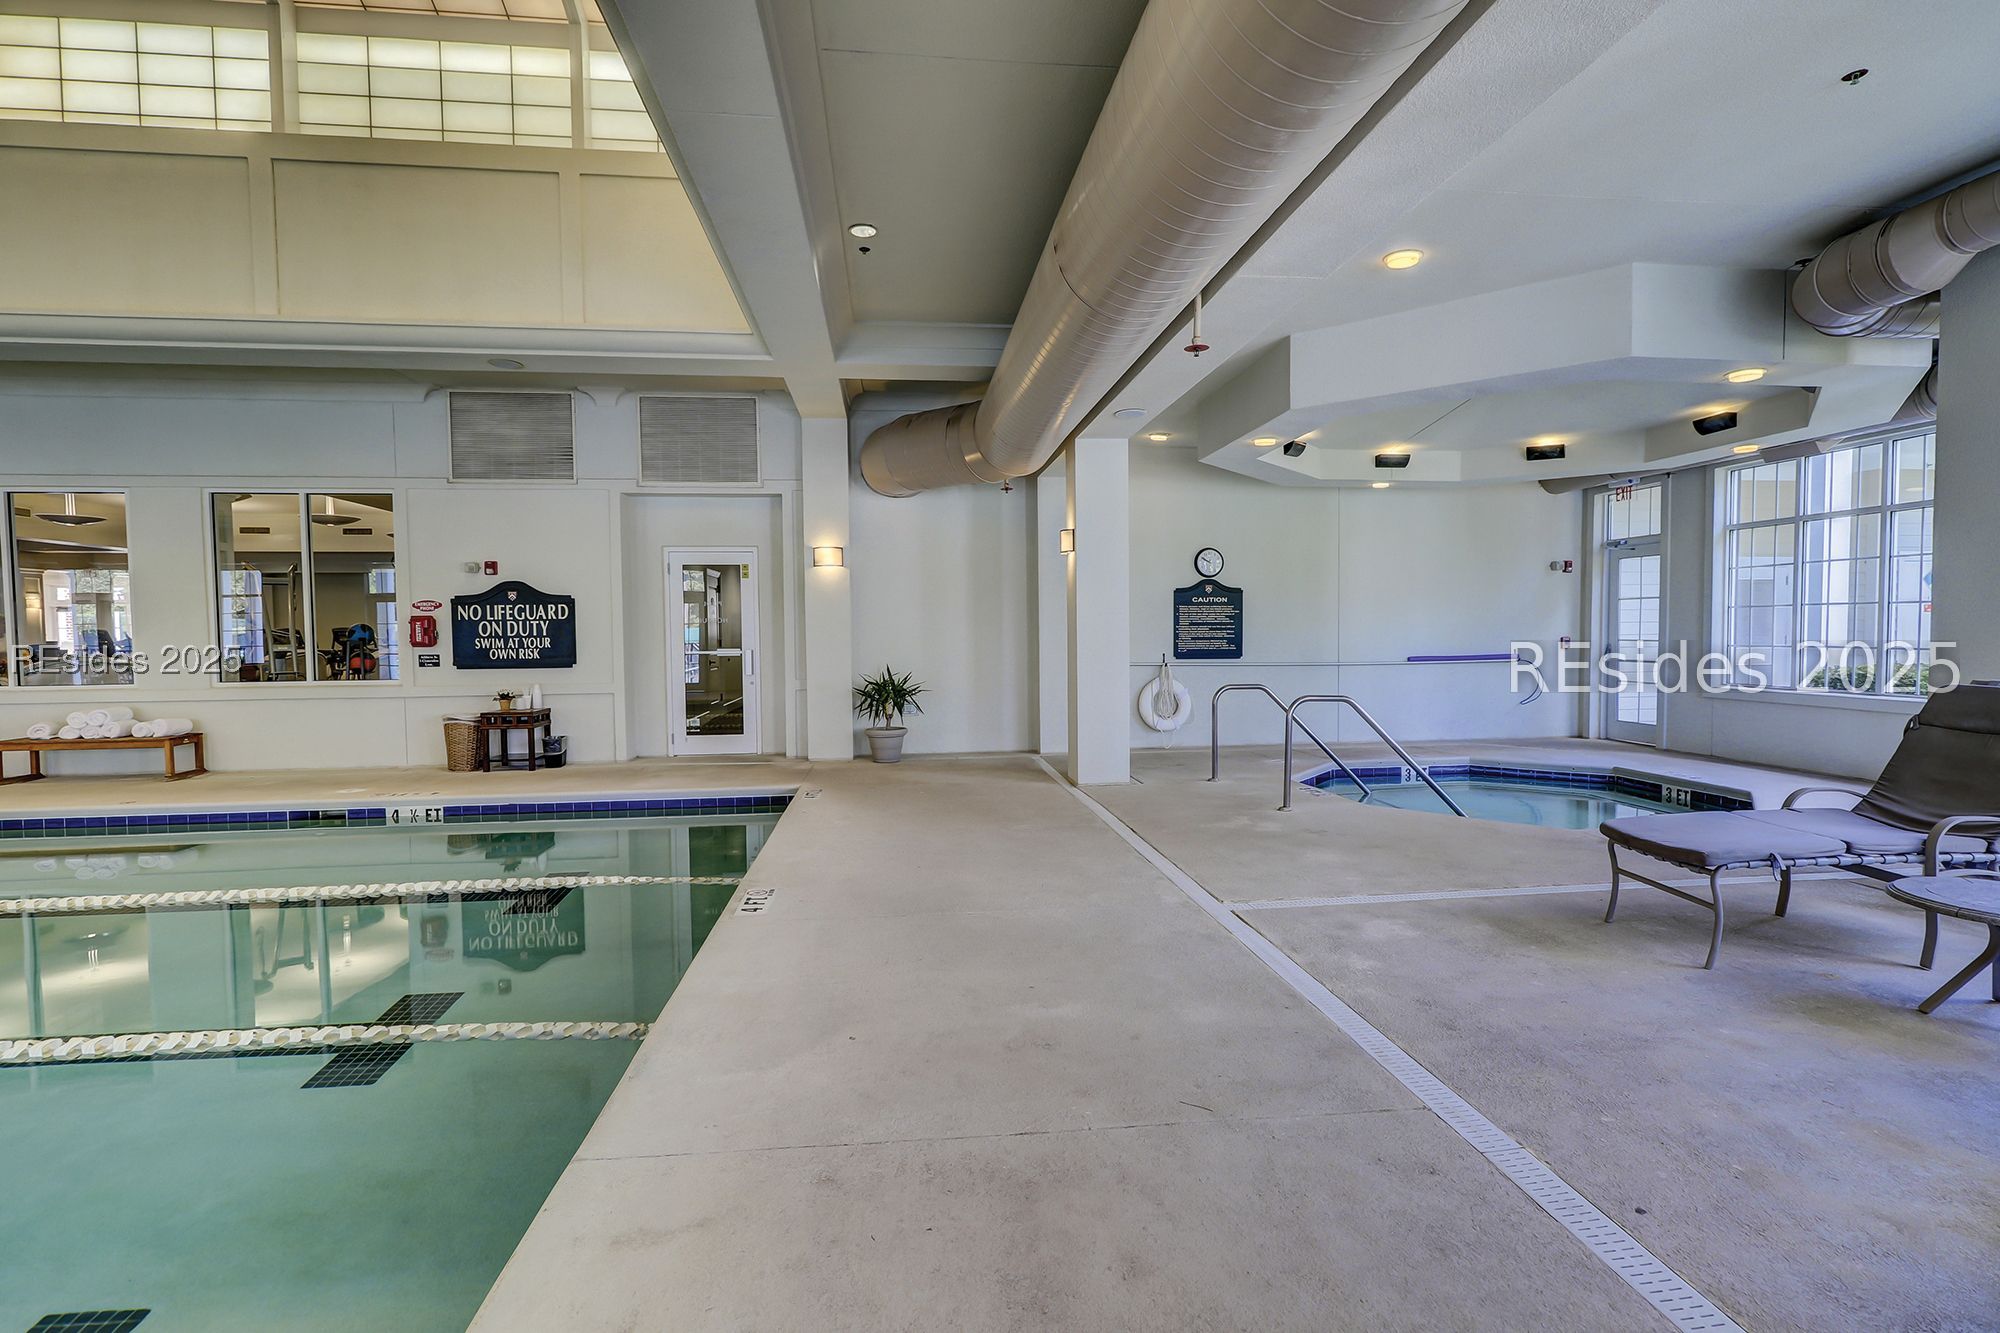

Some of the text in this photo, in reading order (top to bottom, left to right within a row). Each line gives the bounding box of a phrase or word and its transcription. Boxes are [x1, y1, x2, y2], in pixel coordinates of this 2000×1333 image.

[1616, 485, 1632, 501] EXIT
[457, 604, 569, 621] NO LIFEGUARD
[478, 620, 549, 637] ON DUTY
[474, 637, 552, 649] SWIM AT YOUR
[489, 648, 541, 660] OWN RISK
